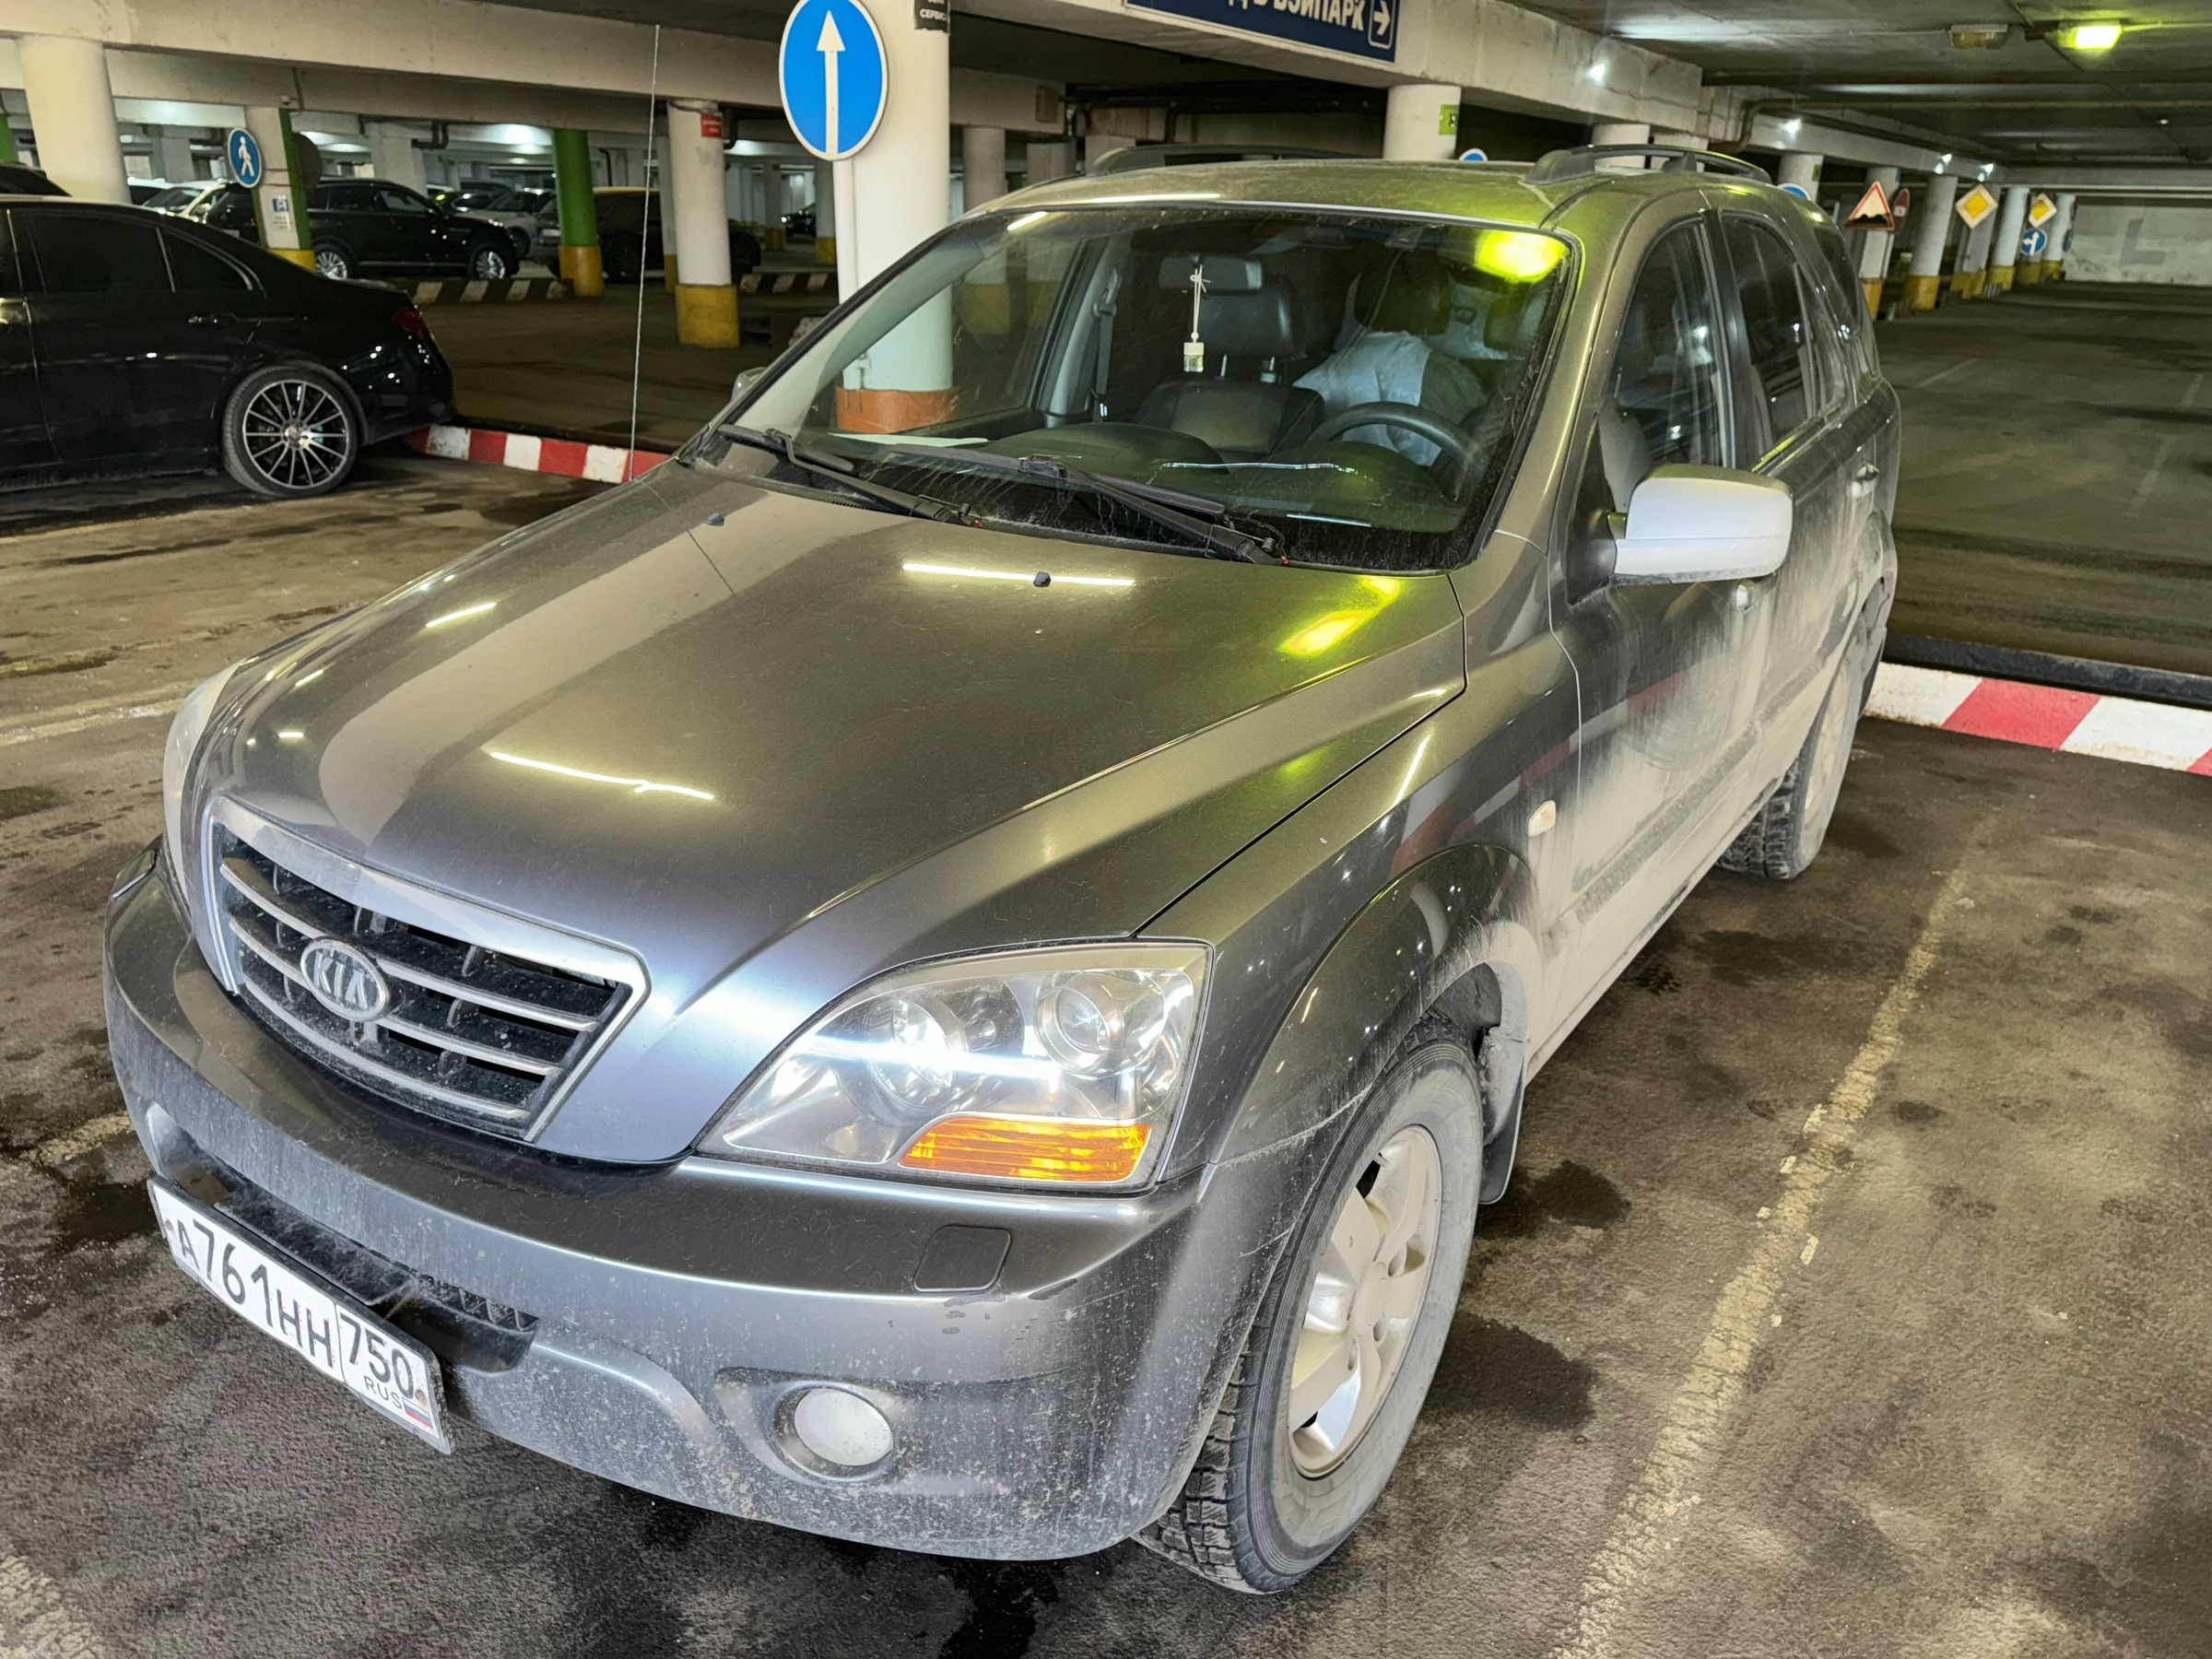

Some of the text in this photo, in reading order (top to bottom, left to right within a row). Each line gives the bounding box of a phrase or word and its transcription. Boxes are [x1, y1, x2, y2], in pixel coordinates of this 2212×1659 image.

[313, 950, 369, 1011] KIA
[339, 1312, 415, 1400] 750
[364, 1374, 404, 1410] RUS
